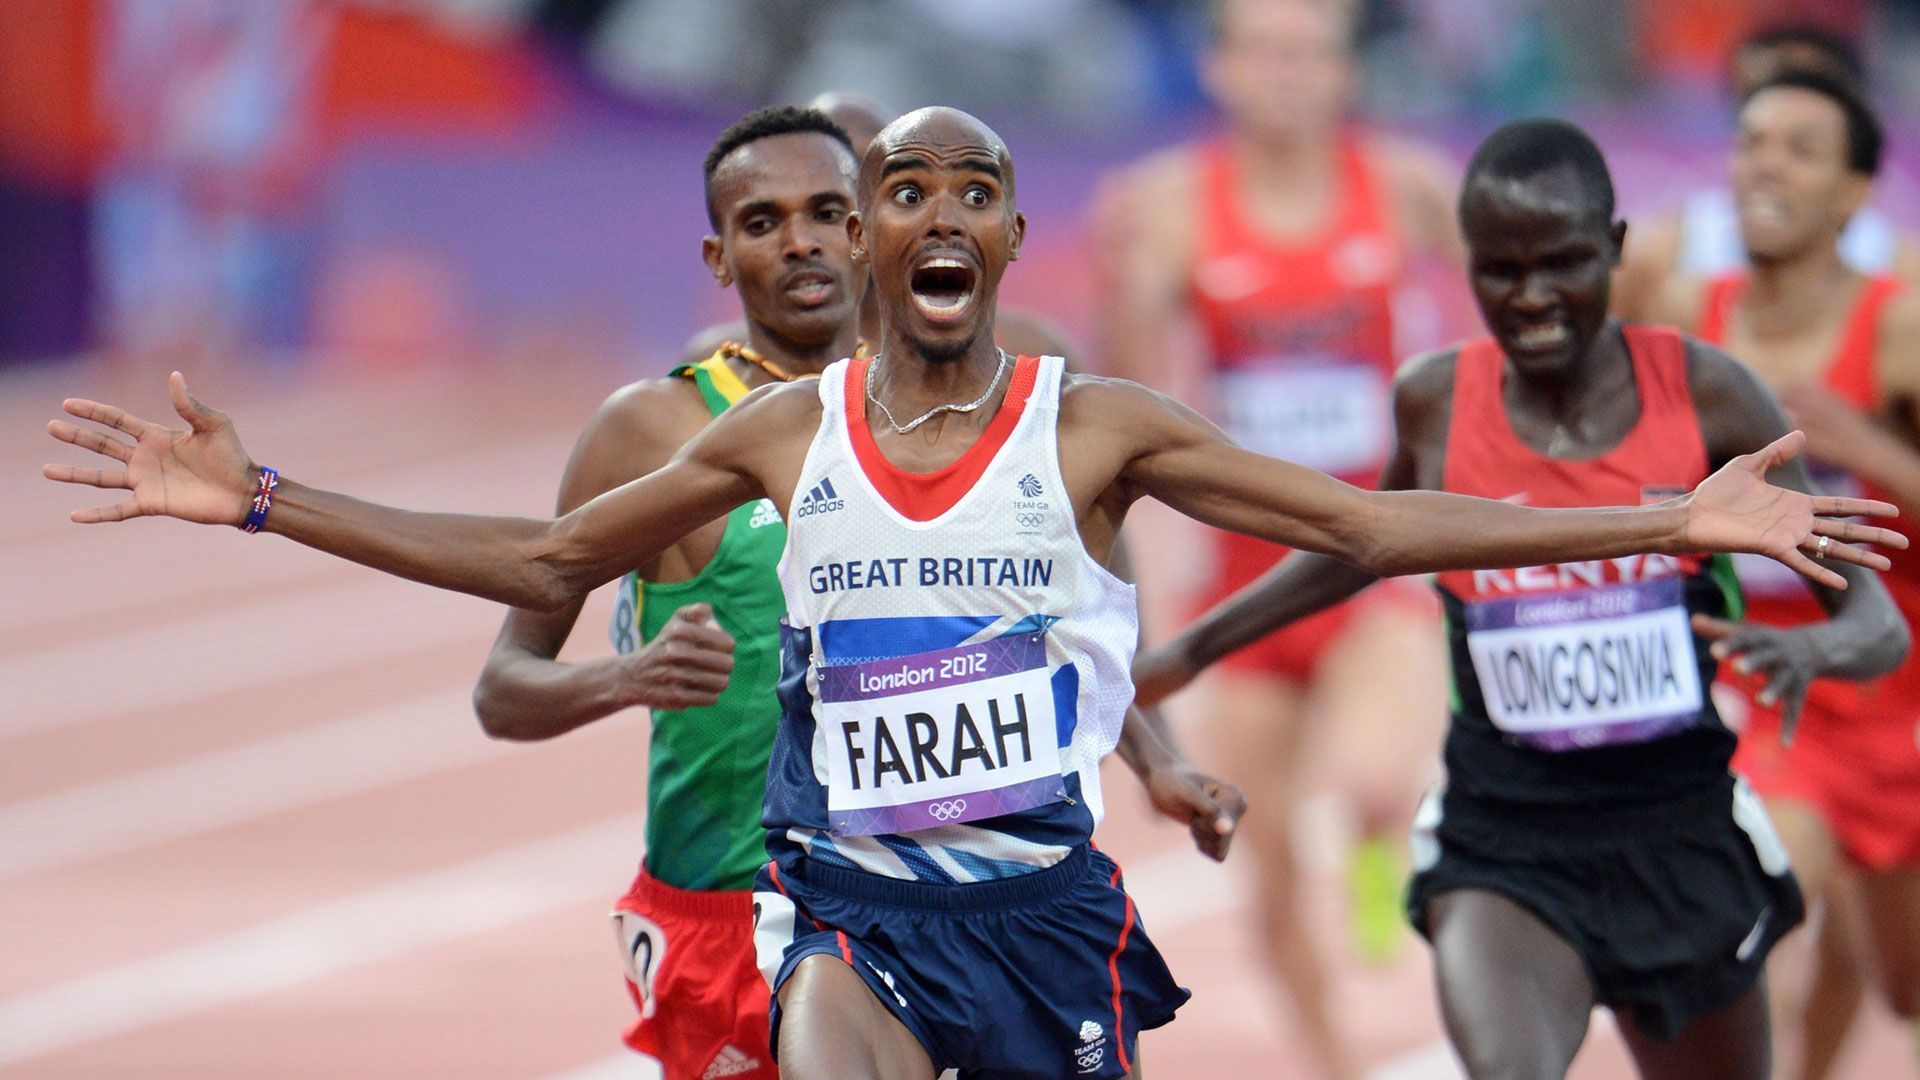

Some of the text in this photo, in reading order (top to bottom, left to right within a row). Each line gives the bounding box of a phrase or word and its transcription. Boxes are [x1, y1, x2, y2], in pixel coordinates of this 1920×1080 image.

[798, 500, 844, 517] adidas
[1014, 502, 1035, 510] TEAM
[809, 558, 1053, 594] GREAT BRITAIN
[860, 653, 988, 693] London 2012
[842, 693, 1032, 790] FARAH
[1074, 1042, 1095, 1056] TEAM
